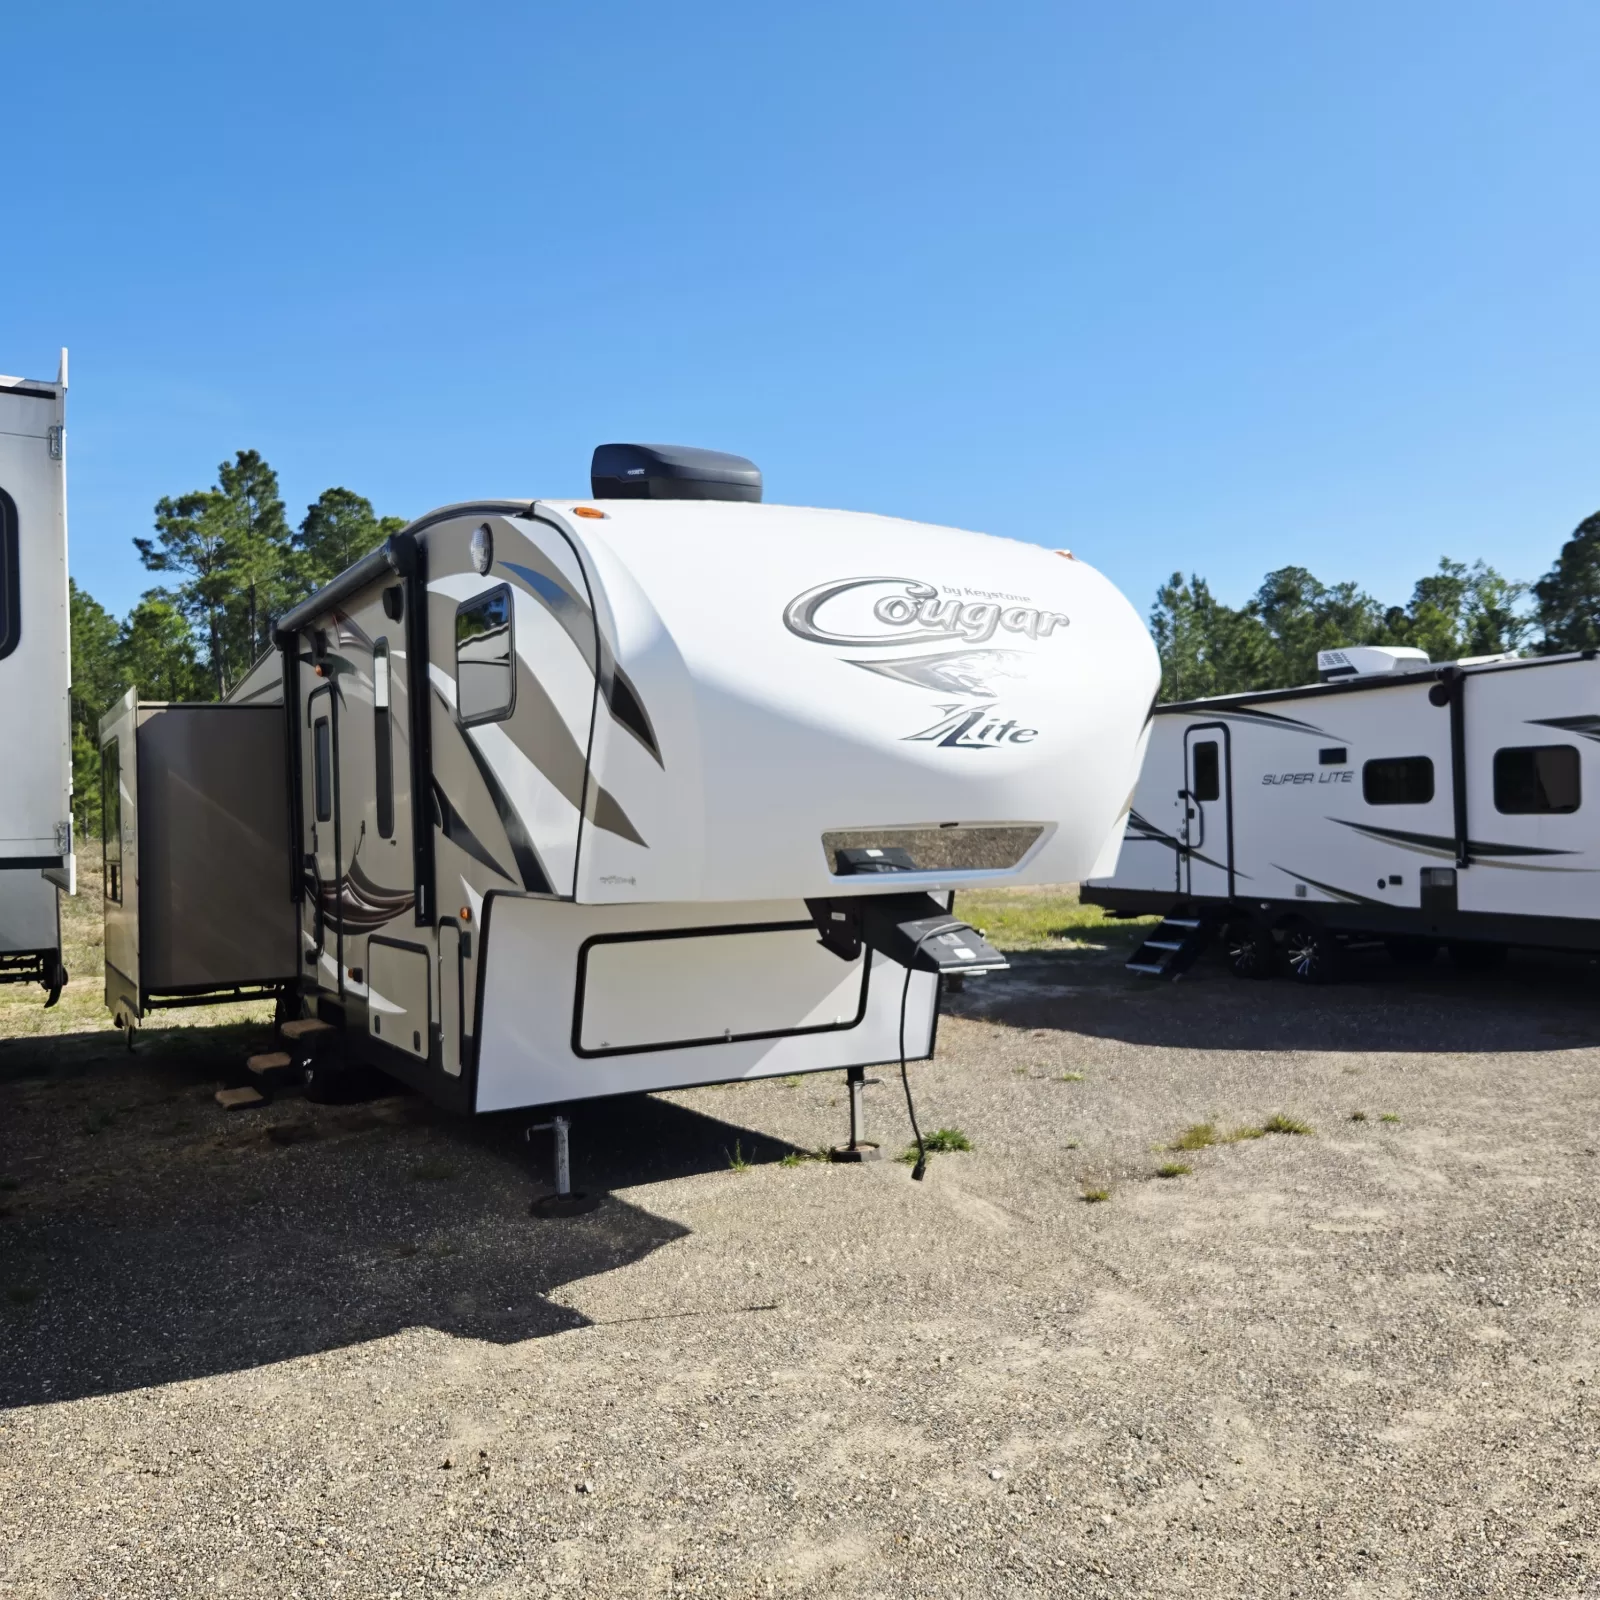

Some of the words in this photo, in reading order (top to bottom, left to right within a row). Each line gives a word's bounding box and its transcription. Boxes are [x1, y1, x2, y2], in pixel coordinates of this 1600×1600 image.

[942, 585, 962, 597] by
[963, 587, 1032, 603] Keystone
[782, 576, 1070, 647] Cougar
[1261, 772, 1315, 785] SUPER
[1318, 770, 1354, 783] LITE
